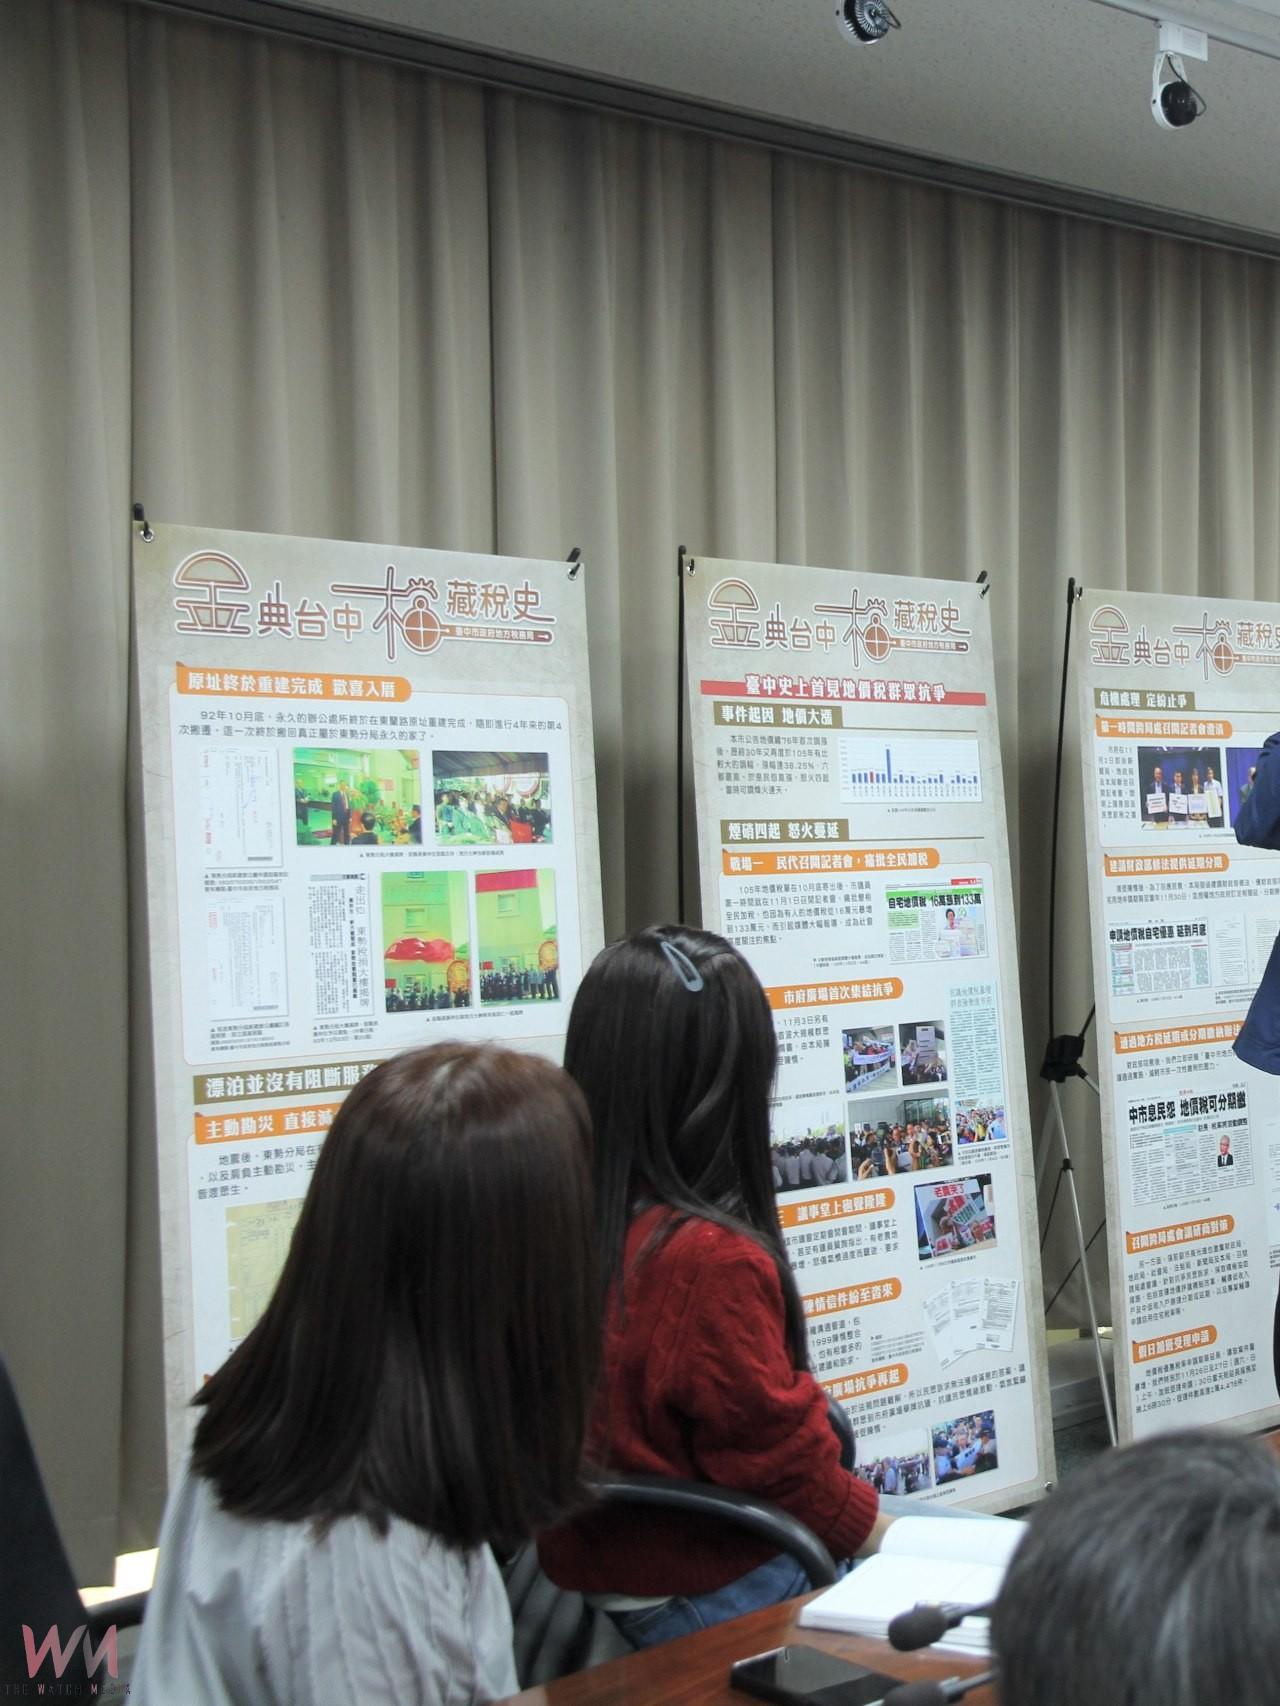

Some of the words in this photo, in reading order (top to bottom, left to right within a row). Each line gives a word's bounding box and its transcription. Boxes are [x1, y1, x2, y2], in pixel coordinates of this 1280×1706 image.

[188, 671, 324, 696] 原址終於重建完成
[745, 674, 946, 702] 臺中史上首見地價稅群眾抗爭
[721, 705, 775, 724] 事件起因
[782, 707, 833, 726] 地價大漲
[1128, 1101, 1176, 1125] 中市息民怨
[1180, 1090, 1247, 1116] 地價稅可分期繳
[207, 1114, 274, 1140] 主動勘災
[283, 1109, 336, 1131] 直接減
